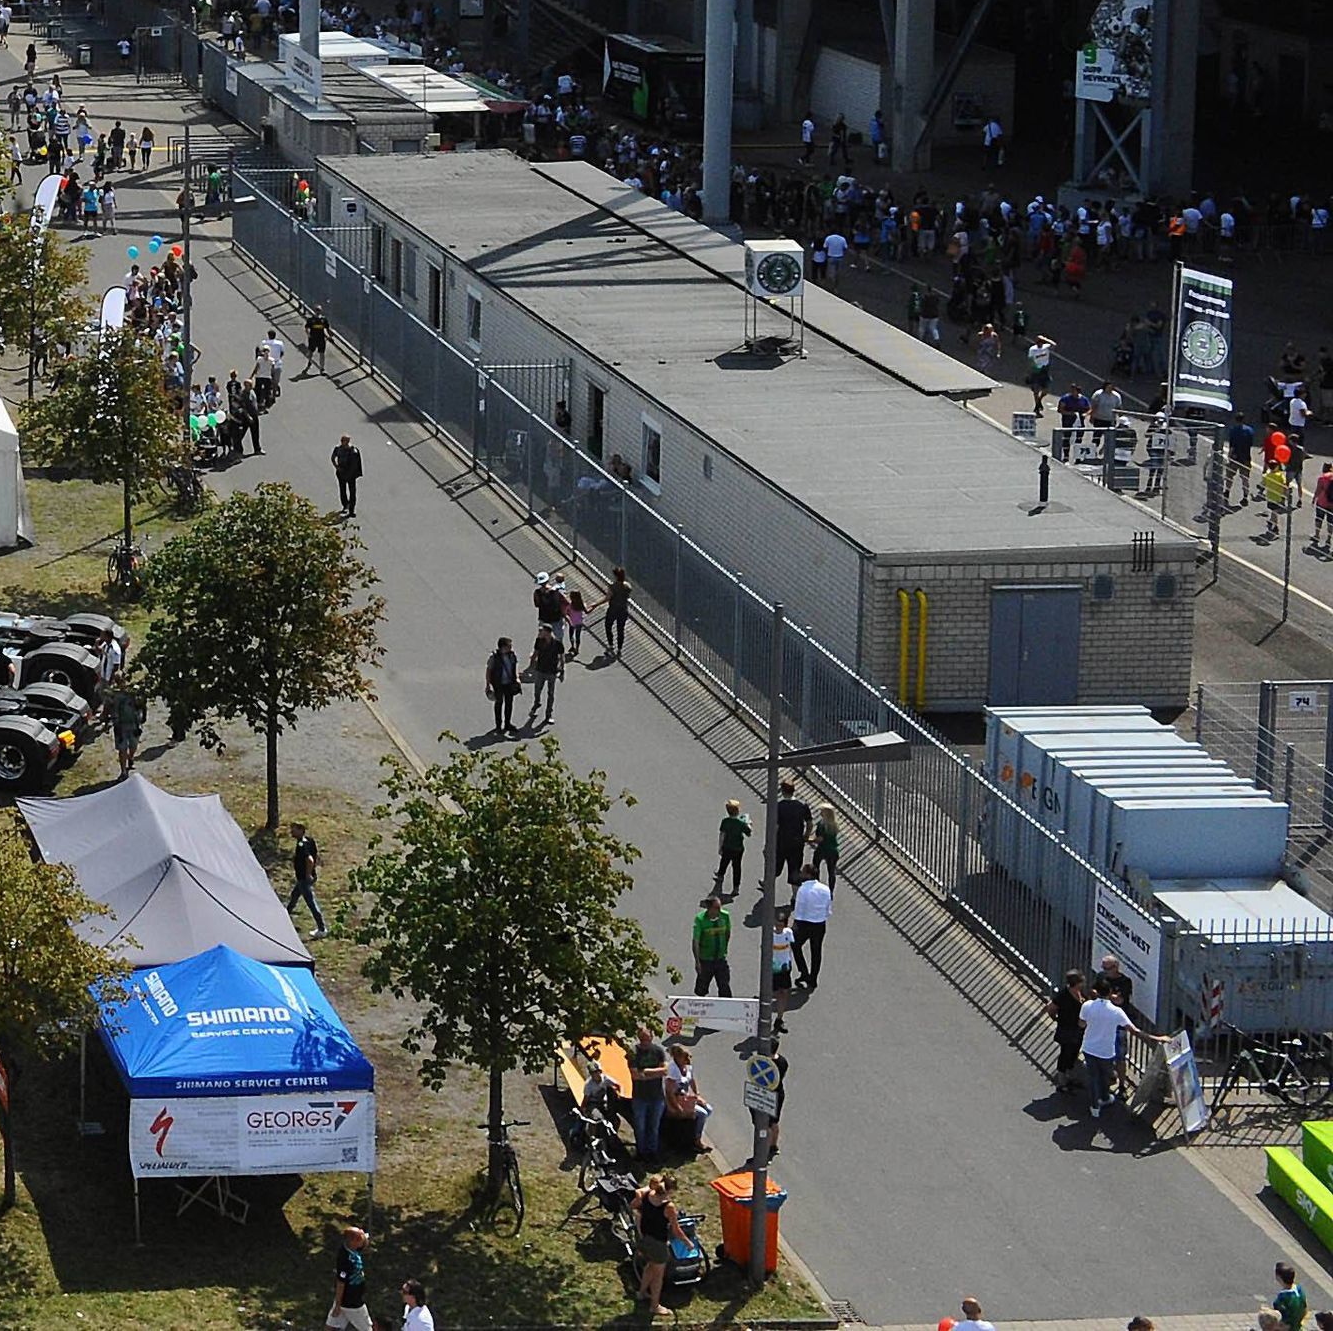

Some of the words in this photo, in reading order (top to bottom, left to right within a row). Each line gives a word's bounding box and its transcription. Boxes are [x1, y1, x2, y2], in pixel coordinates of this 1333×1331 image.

[1083, 45, 1097, 64] 9
[1096, 901, 1131, 939] EINGANG
[1130, 929, 1152, 955] WEST
[143, 971, 180, 1018] SHIMANO
[186, 1006, 291, 1027] SHIMANO
[190, 1028, 241, 1038] SERVICE
[242, 1027, 295, 1036] CENTER
[175, 1079, 231, 1090] SHIMANO
[234, 1078, 282, 1088] SERVICE
[285, 1076, 329, 1087] CENTER
[247, 1110, 332, 1129] GEORGS
